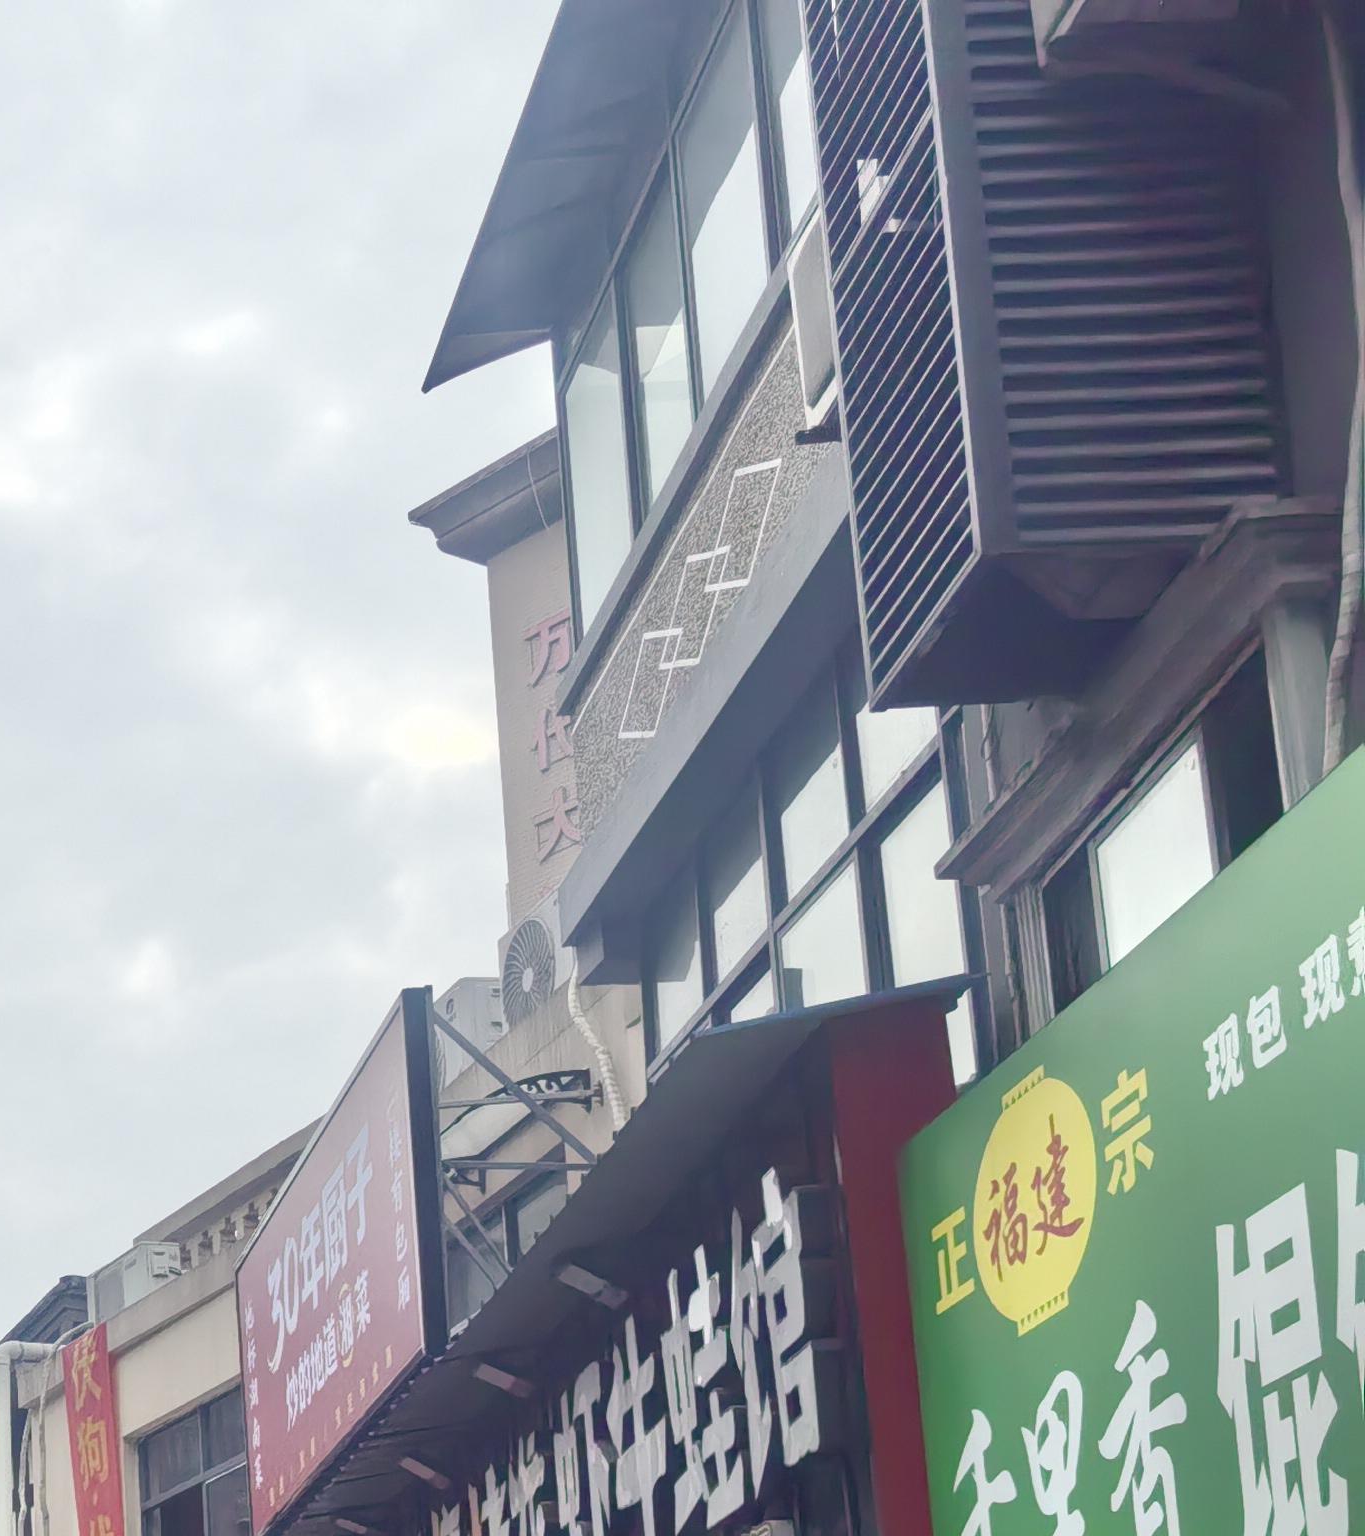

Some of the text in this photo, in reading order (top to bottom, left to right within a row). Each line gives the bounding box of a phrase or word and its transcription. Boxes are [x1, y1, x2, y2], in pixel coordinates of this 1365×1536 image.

[1202, 985, 1286, 1100] 现包
[268, 1128, 374, 1374] 30年厨子
[983, 1134, 1085, 1277] 福建
[286, 1268, 371, 1432] 炒的地道湘菜
